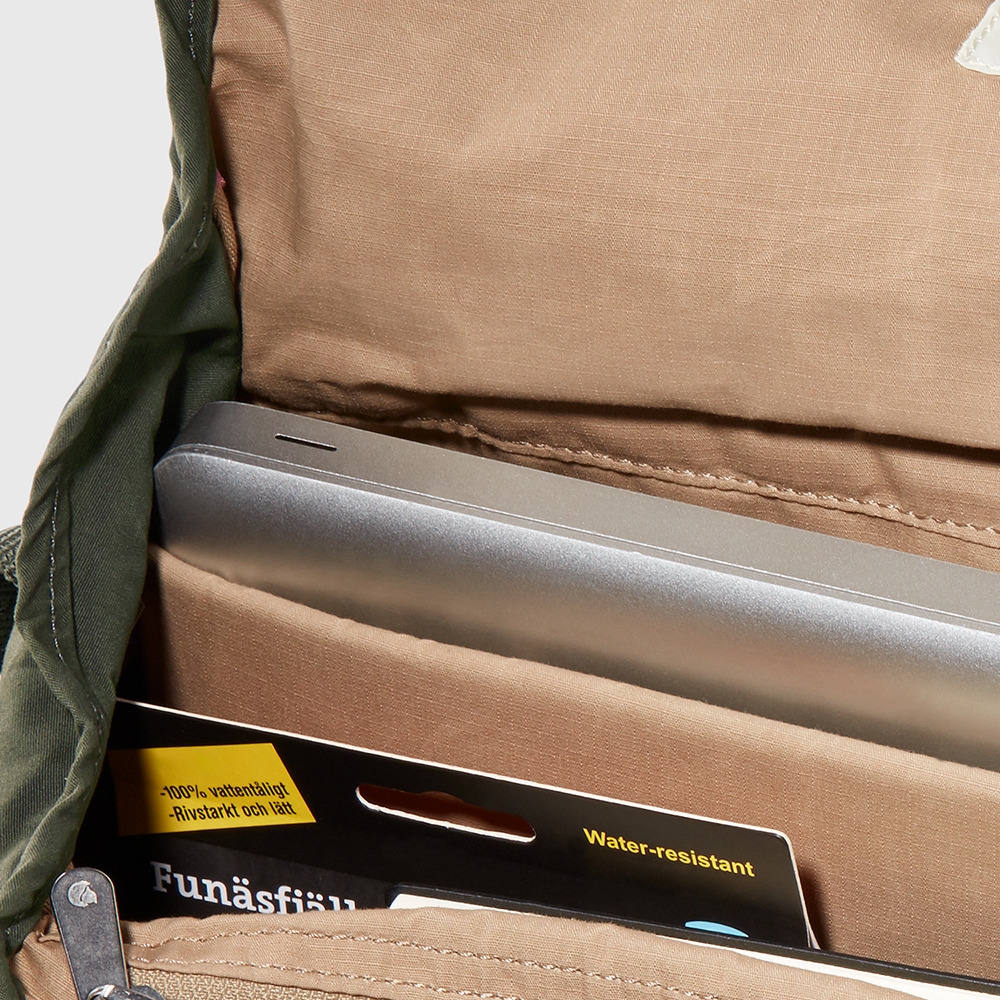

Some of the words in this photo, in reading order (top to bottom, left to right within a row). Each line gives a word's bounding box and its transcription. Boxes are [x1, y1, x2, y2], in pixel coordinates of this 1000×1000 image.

[160, 785, 207, 800] -100%
[208, 781, 290, 800] vattentåligt
[169, 802, 238, 822] -Rivstarkt
[242, 802, 269, 819] och
[271, 800, 297, 816] lätt
[583, 827, 755, 877] Water-resistant
